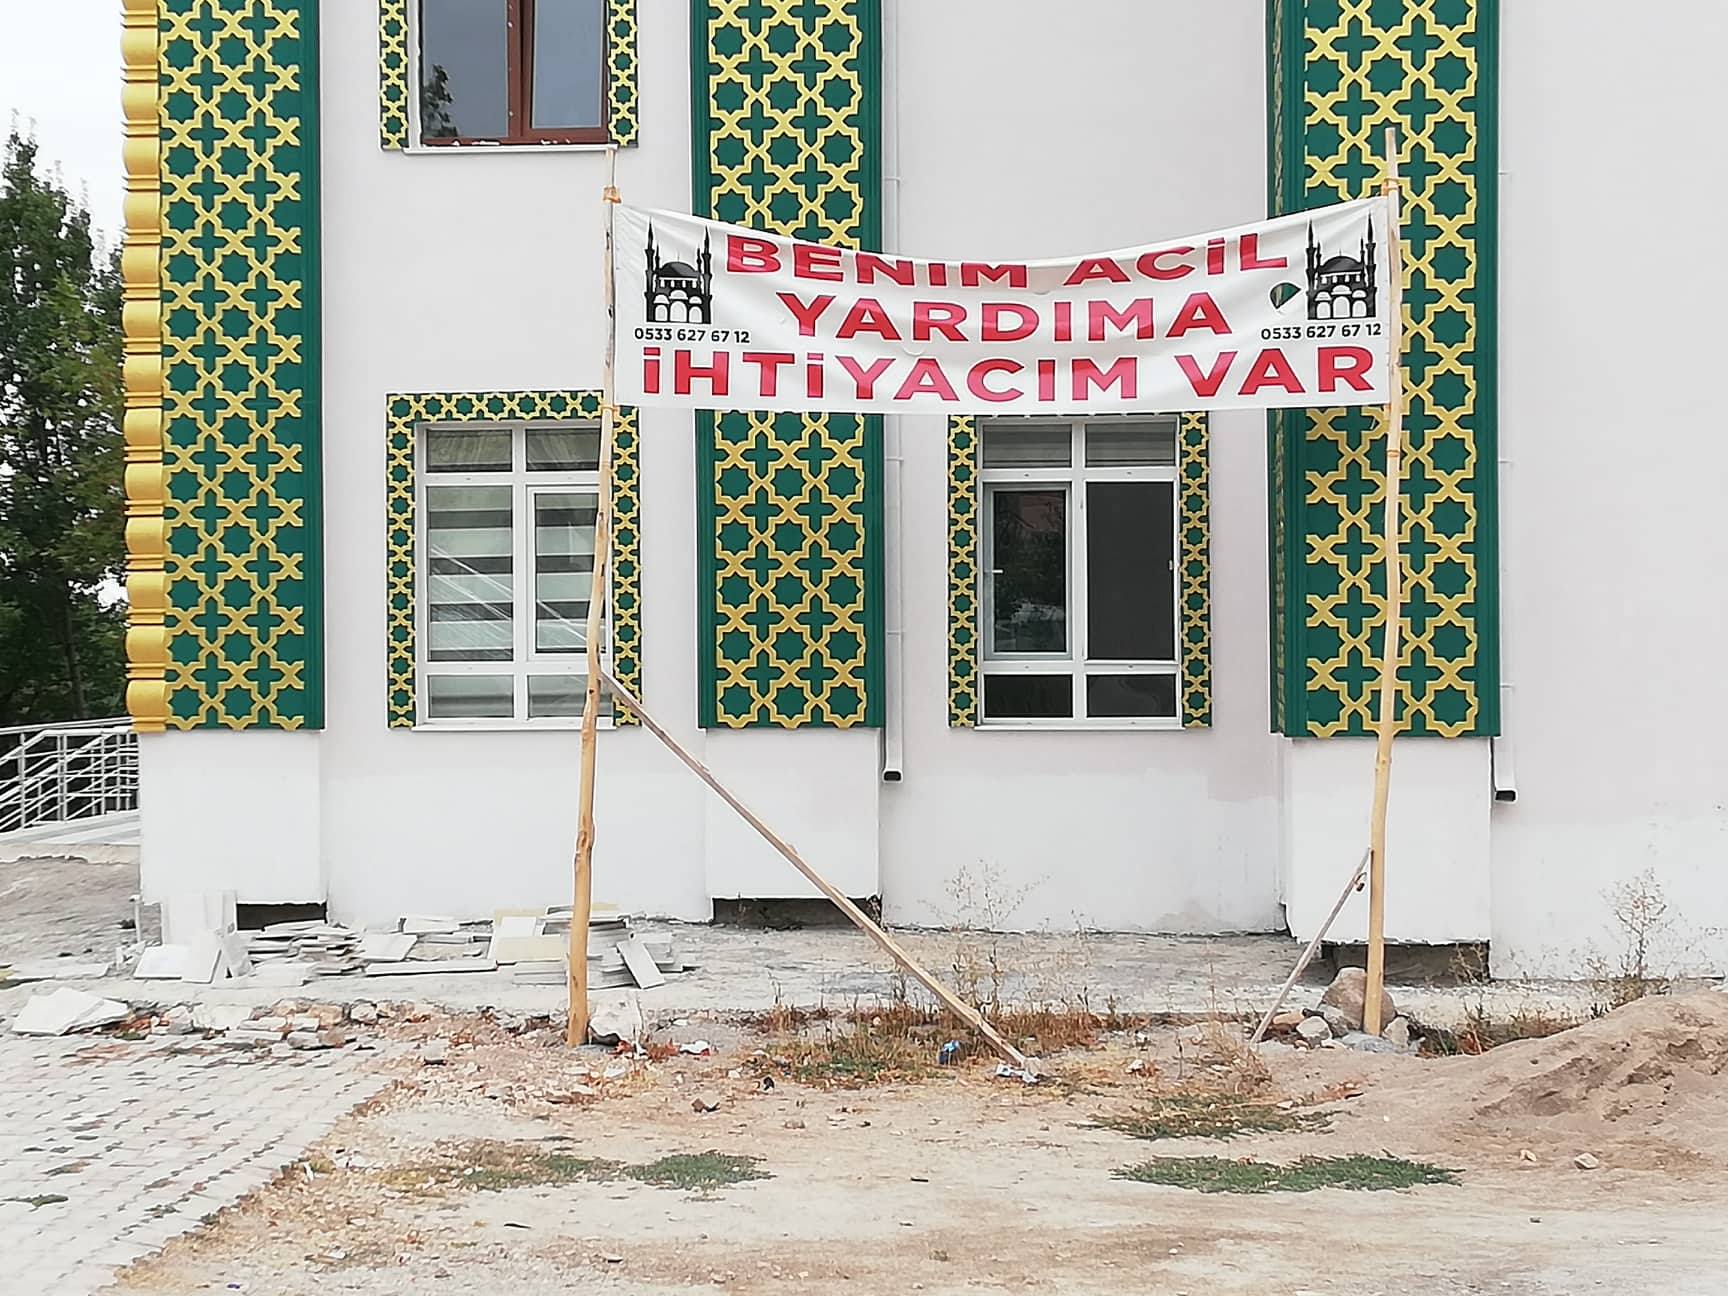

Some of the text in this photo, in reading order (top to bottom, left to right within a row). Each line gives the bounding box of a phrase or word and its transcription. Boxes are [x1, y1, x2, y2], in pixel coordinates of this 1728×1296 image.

[776, 292, 1232, 343] YARDIMA
[1261, 322, 1381, 340] 0533 627 67 12
[634, 327, 751, 344] 0533 627 67 12
[1174, 346, 1375, 397] VAR
